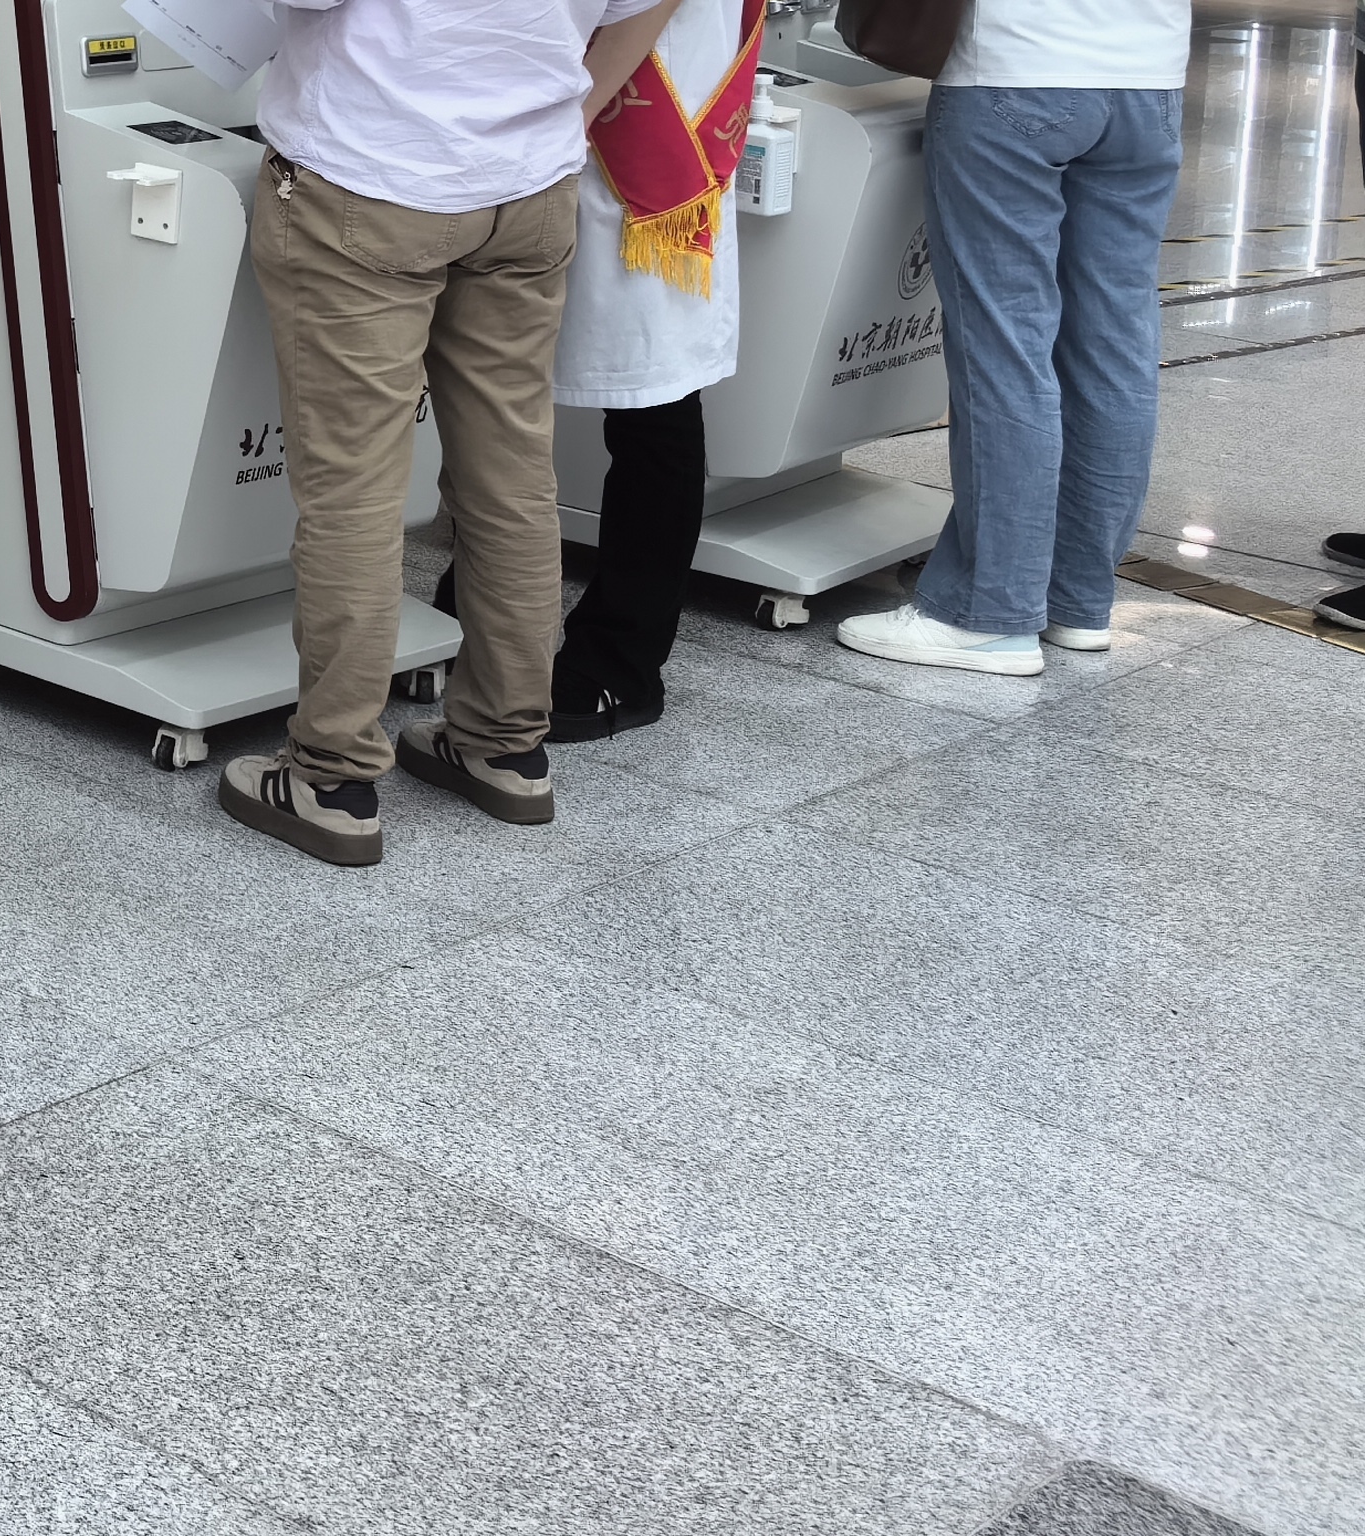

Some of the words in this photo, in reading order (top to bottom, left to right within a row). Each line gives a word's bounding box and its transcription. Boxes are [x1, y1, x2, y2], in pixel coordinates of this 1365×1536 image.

[838, 306, 943, 362] 北京朝阳医
[235, 462, 283, 485] BEIJING
